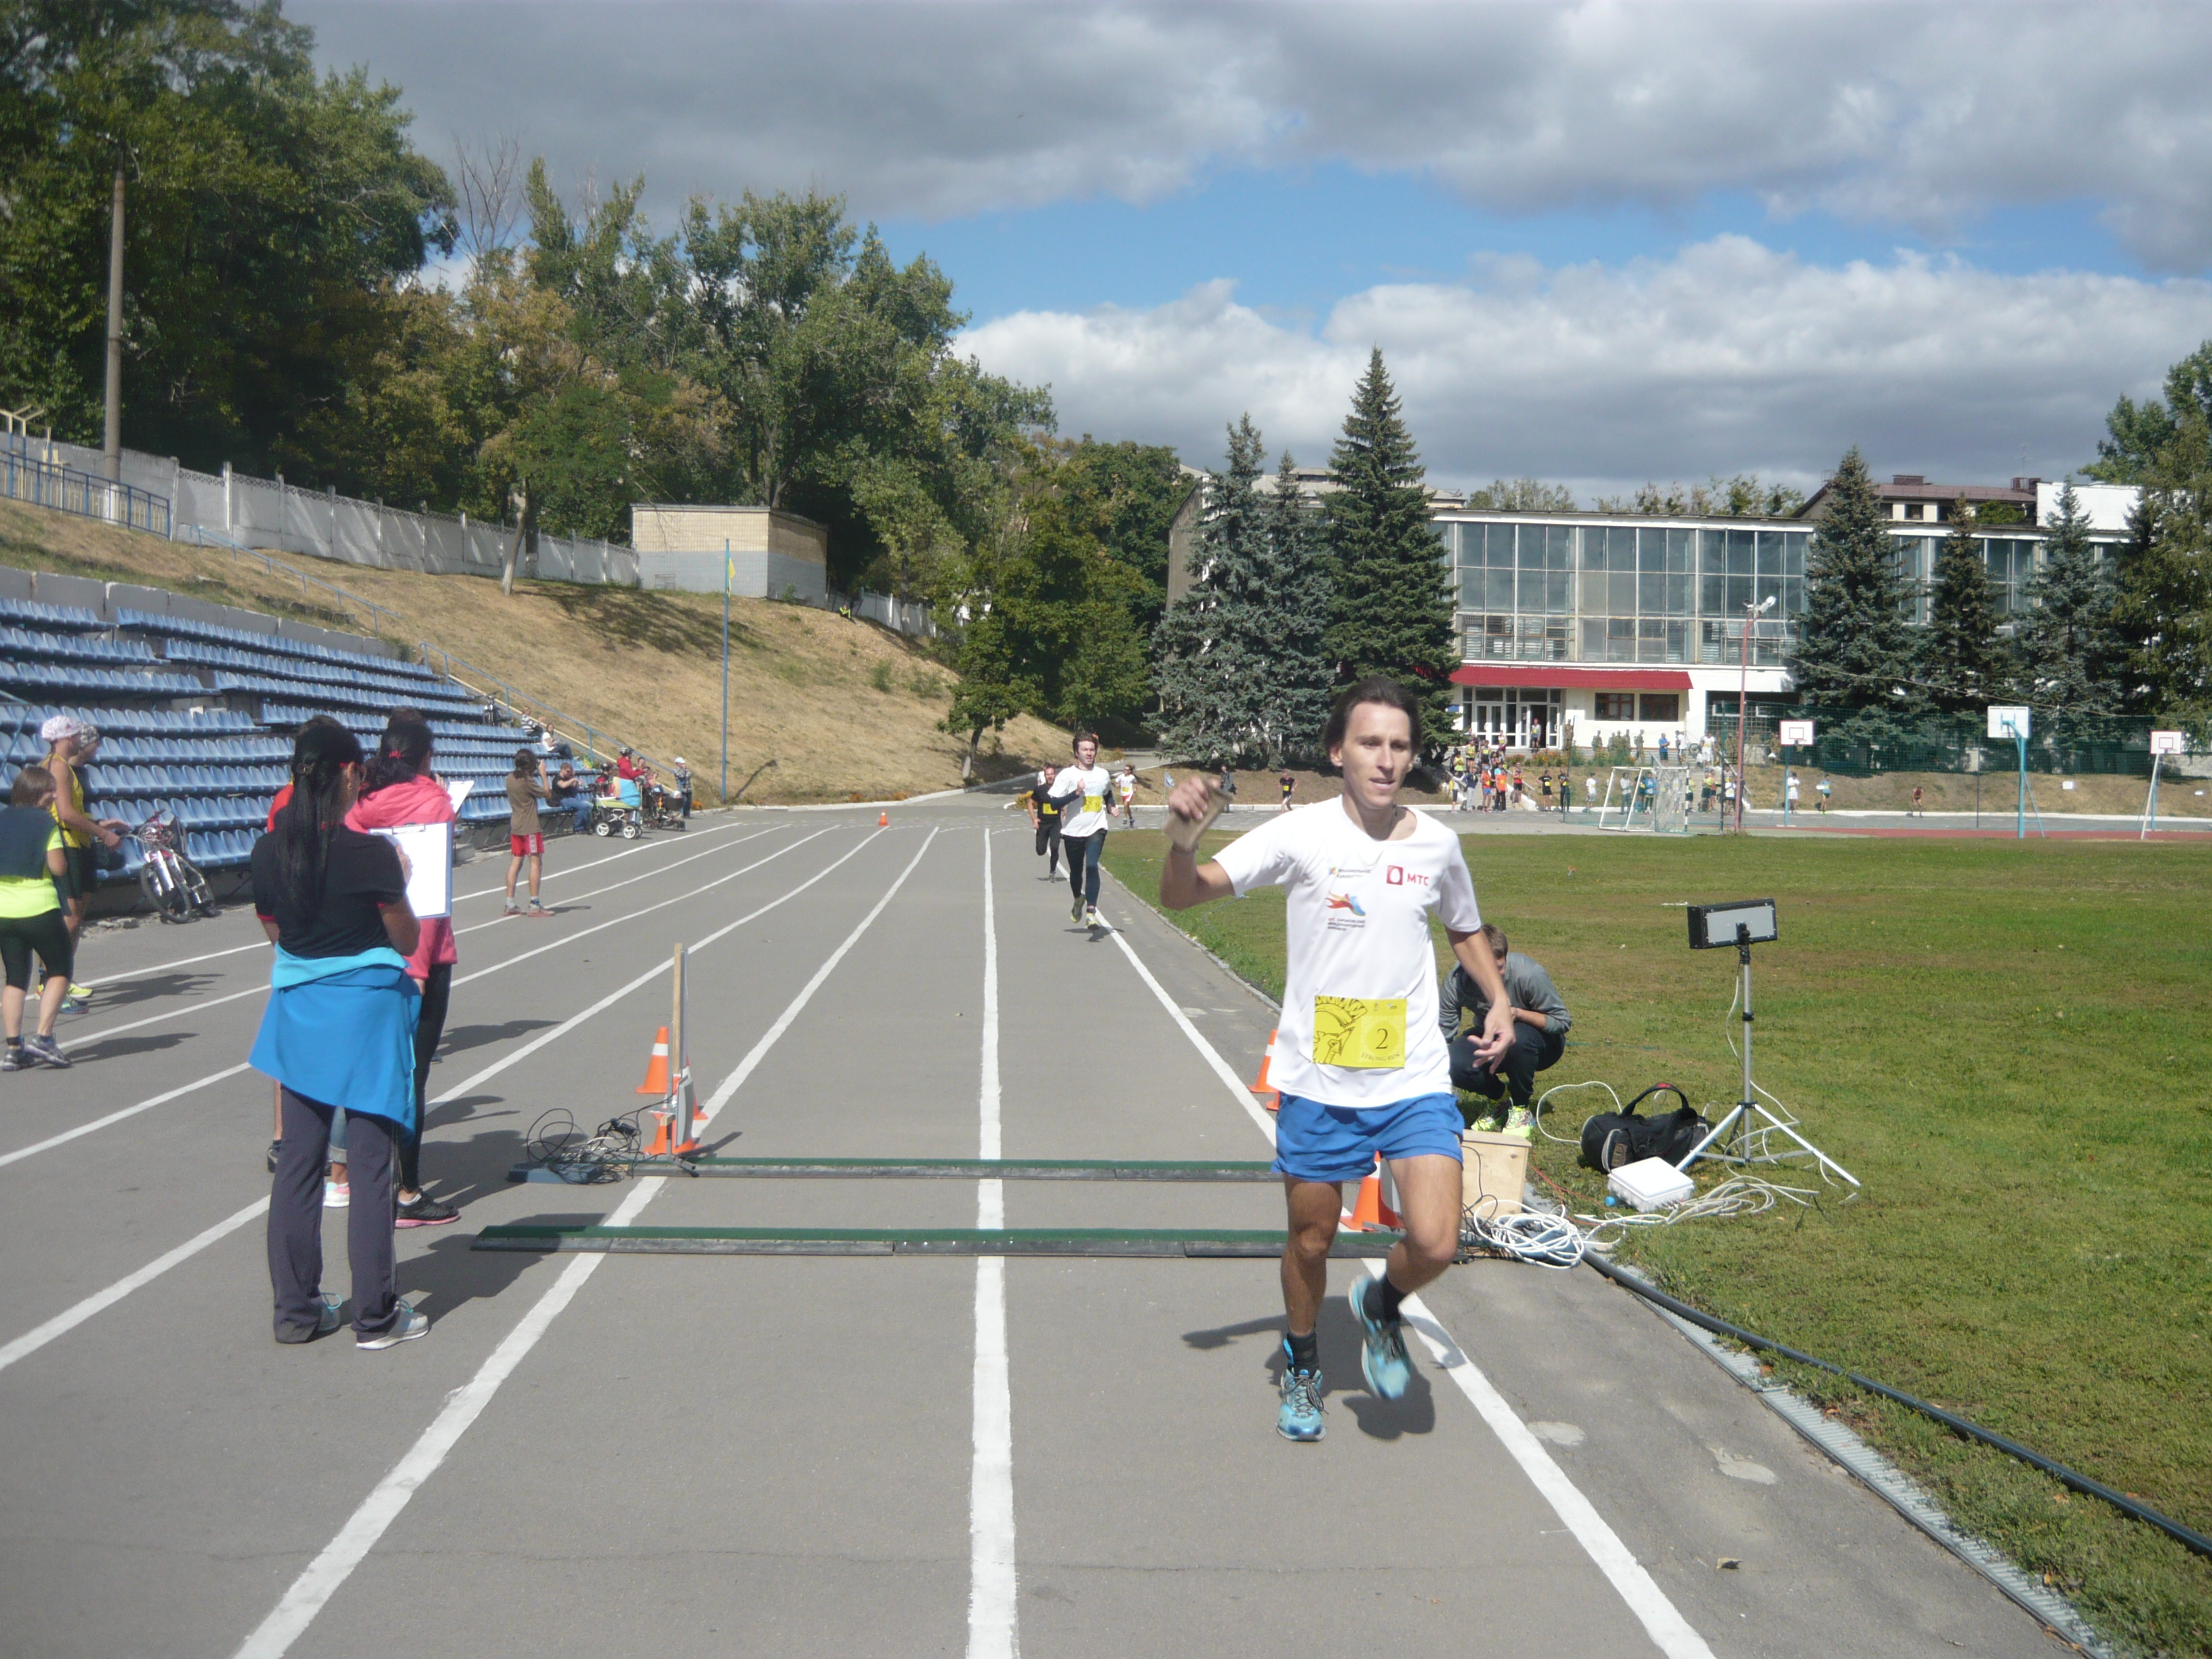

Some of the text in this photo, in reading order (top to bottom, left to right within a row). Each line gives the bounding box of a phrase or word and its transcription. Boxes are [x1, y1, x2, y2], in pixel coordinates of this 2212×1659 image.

[1407, 873, 1429, 886] МТС
[1376, 1028, 1388, 1050] 2
[1361, 1052, 1387, 1061] STRONG
